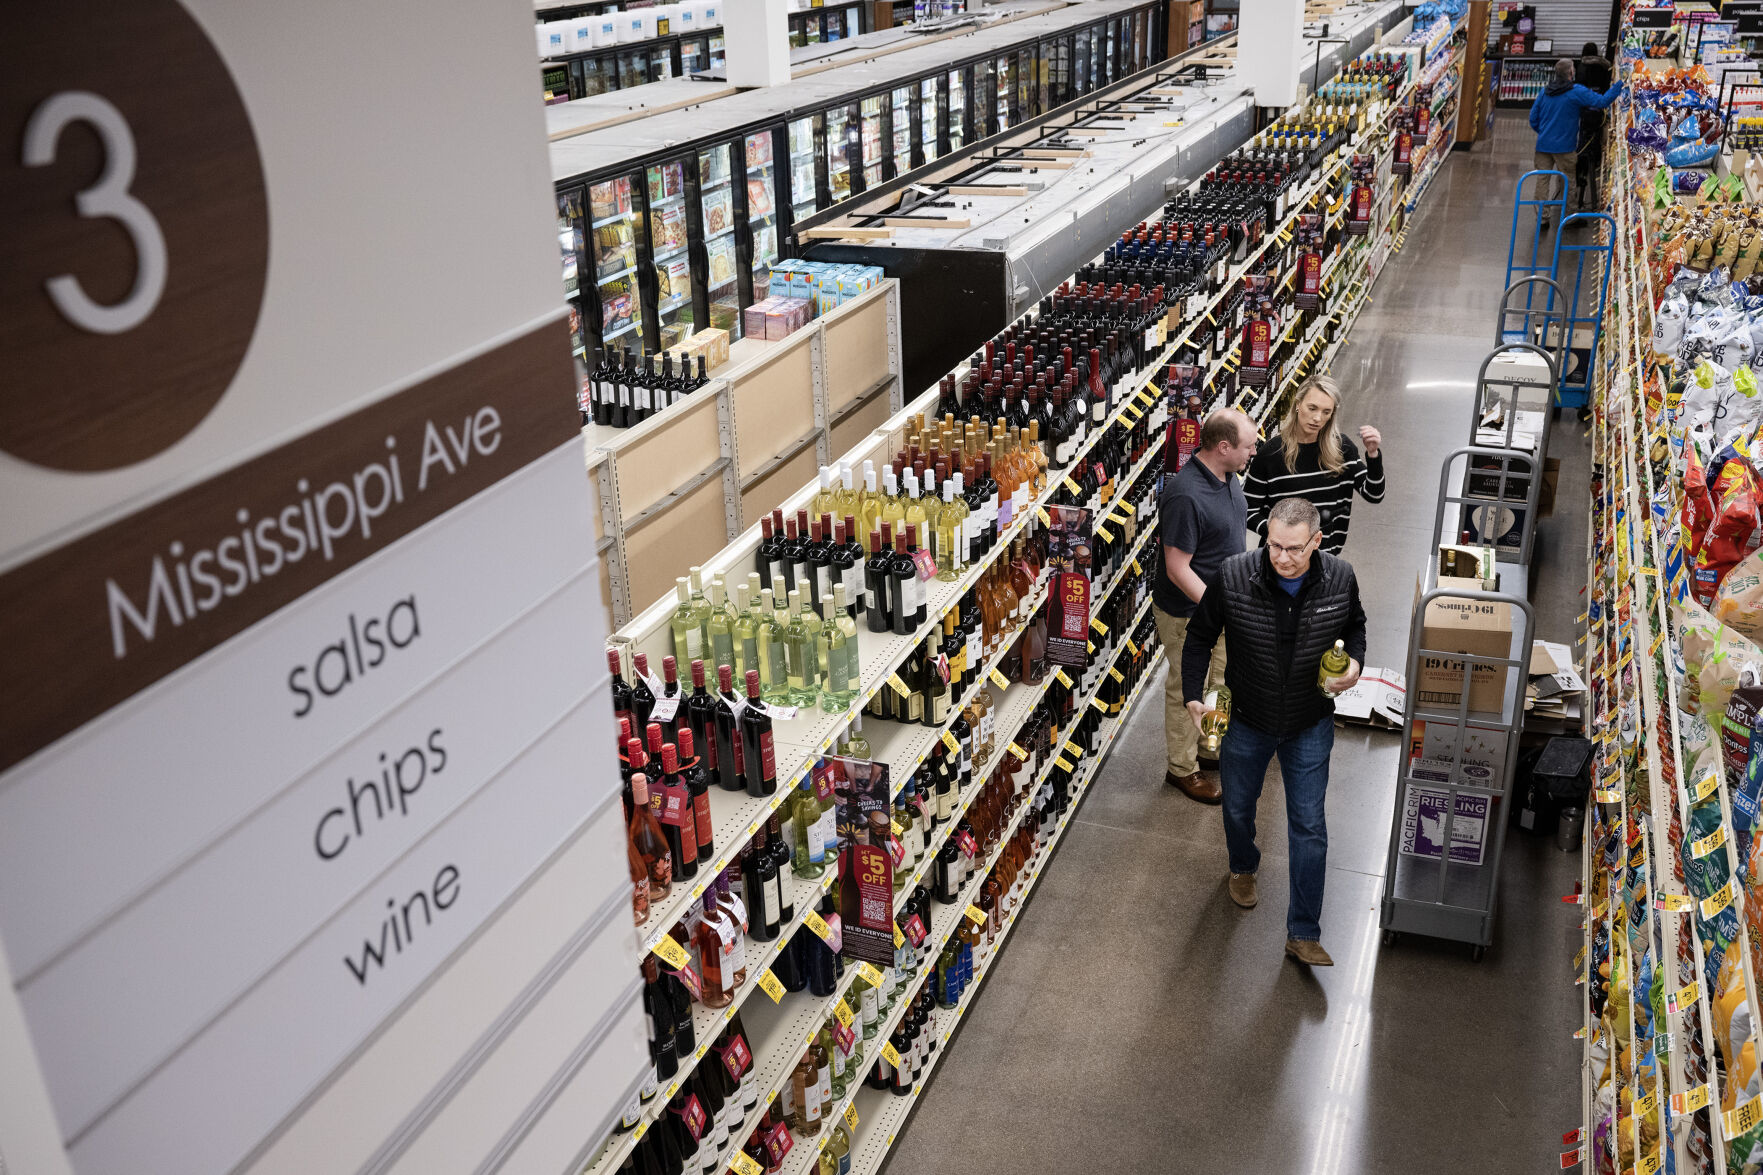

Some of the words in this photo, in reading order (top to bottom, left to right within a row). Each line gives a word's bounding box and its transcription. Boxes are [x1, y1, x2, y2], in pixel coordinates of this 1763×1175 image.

[21, 89, 168, 335] 3
[1255, 325, 1267, 337] $5
[1181, 424, 1195, 437] $5
[106, 435, 403, 660] Mississippi
[417, 405, 502, 491] Ave
[1067, 580, 1084, 595] $5
[1066, 594, 1085, 603] OFF
[287, 593, 422, 719] salsa
[1425, 658, 1440, 669] 19
[313, 727, 448, 861] chips
[651, 795, 661, 805] $5
[1408, 787, 1420, 808] RIM
[1403, 809, 1418, 853] PACIFIC
[861, 855, 885, 875] $5
[862, 873, 887, 886] OFF
[342, 863, 462, 987] wine
[844, 924, 855, 932] WE
[862, 928, 893, 939] EVERYONE
[1738, 1104, 1753, 1132] FREE
